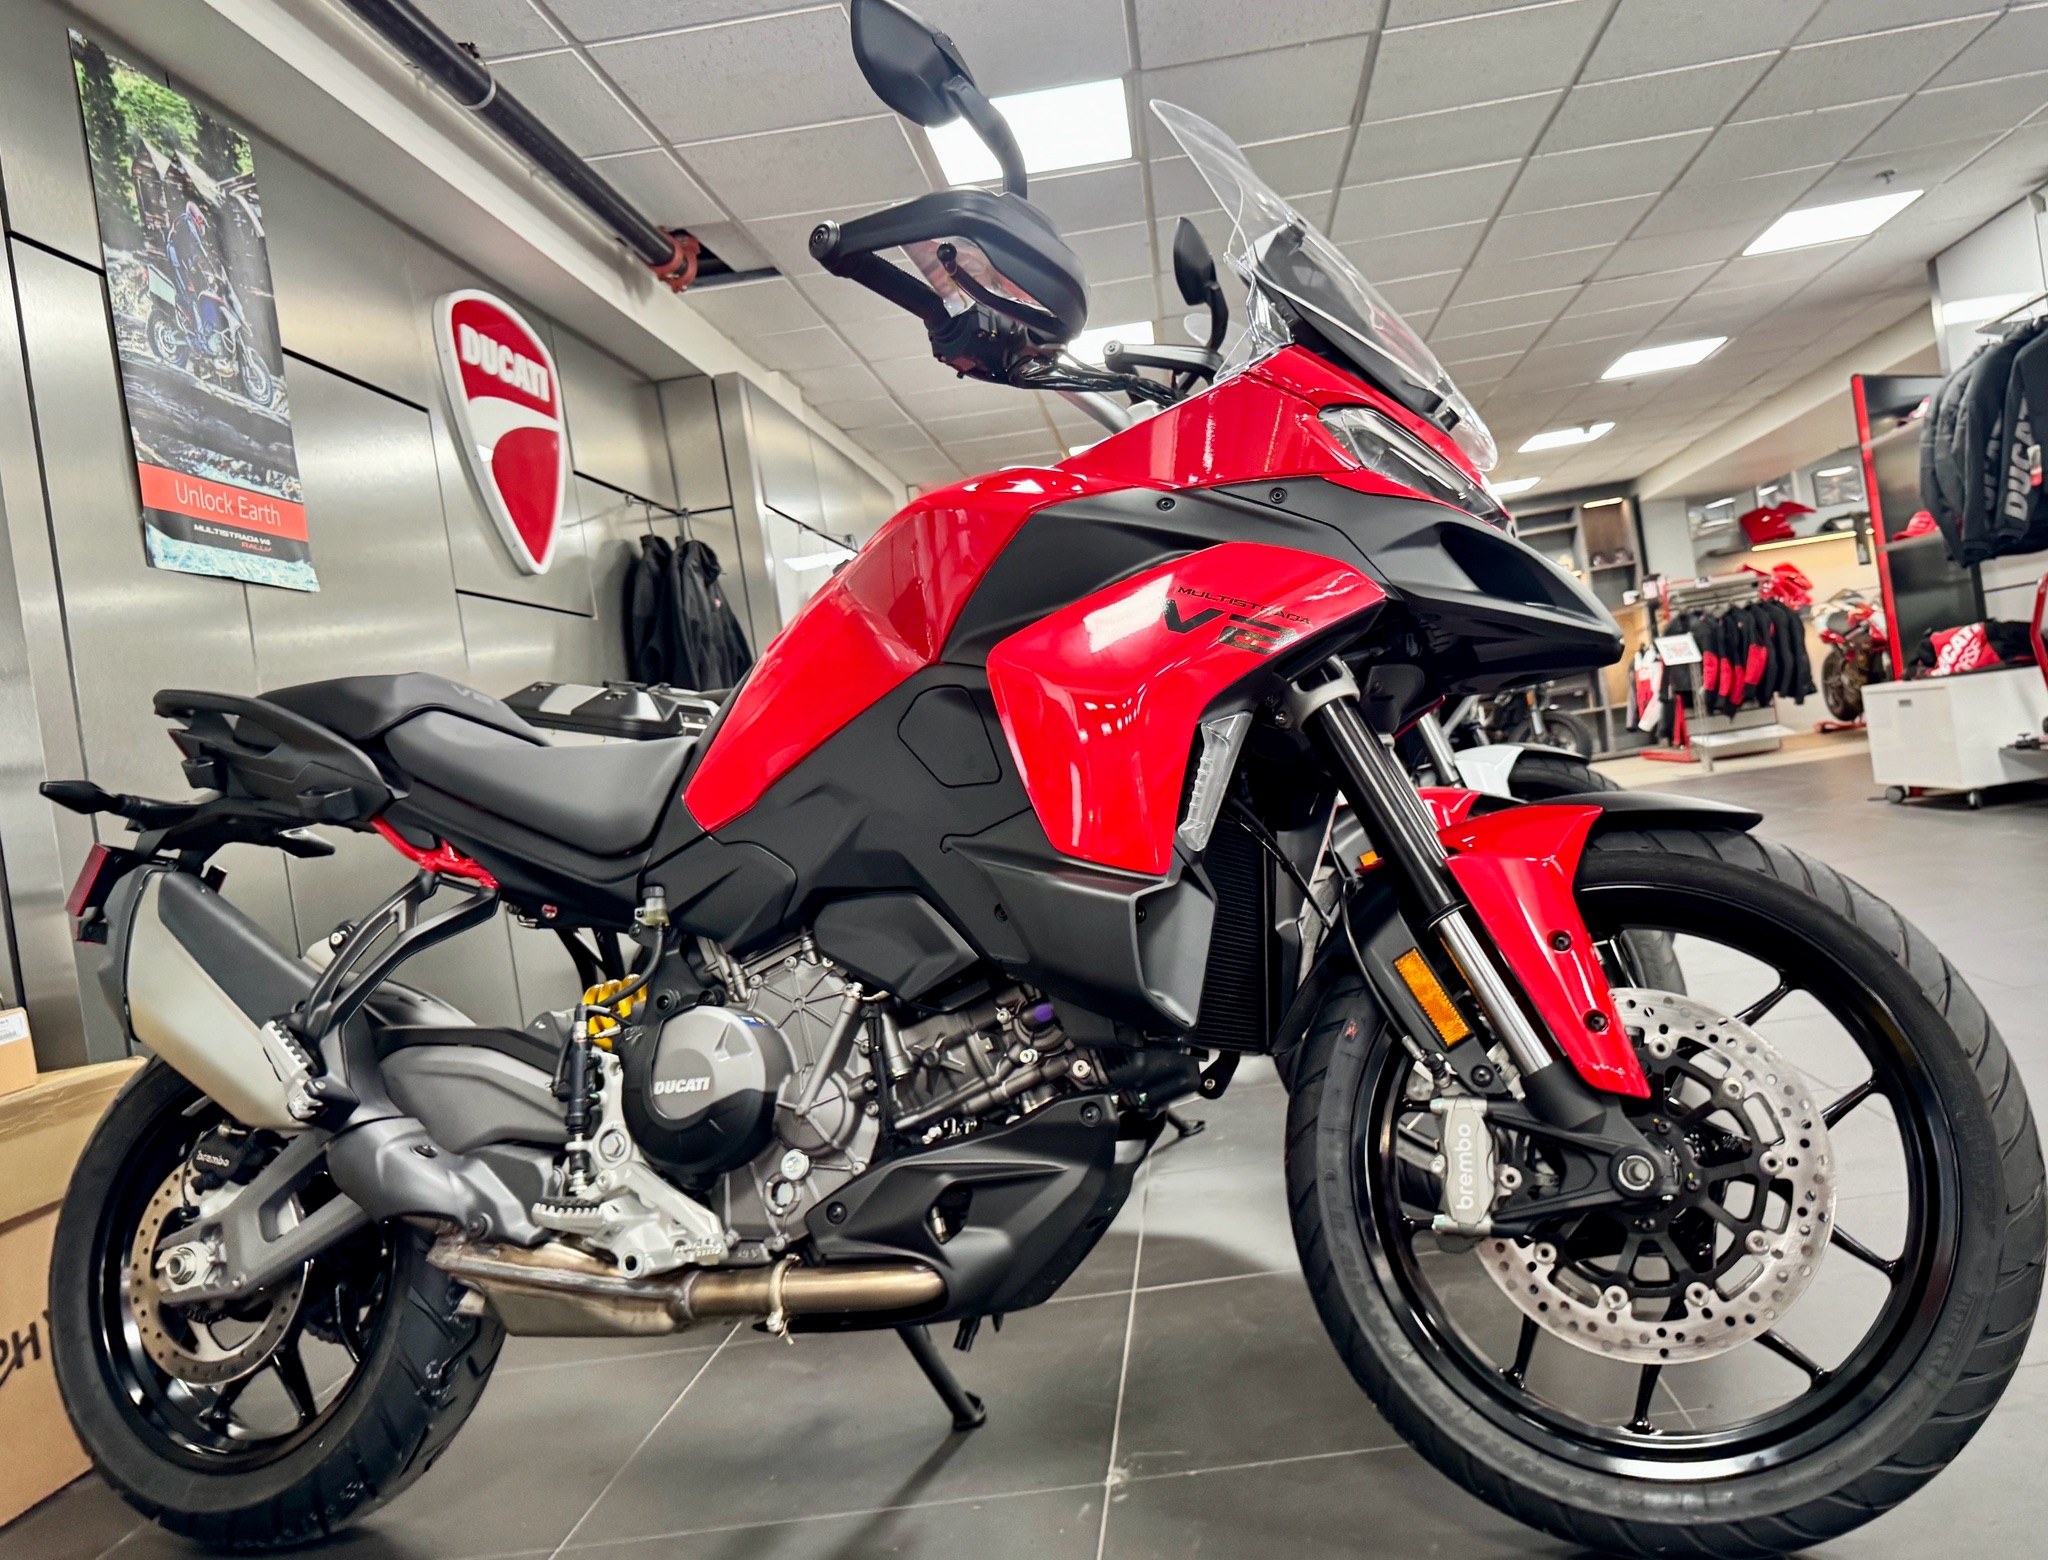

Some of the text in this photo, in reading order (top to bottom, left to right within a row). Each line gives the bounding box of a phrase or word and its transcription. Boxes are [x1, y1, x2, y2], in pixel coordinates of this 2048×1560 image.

[459, 324, 549, 402] DUCATI
[2004, 394, 2033, 520] DUCA
[175, 480, 281, 526] Unlock Earth
[194, 524, 272, 546] MULTISTRADA V4
[1163, 599, 1300, 656] V2
[654, 1076, 710, 1095] DUCATI
[196, 1150, 229, 1167] brembo
[1455, 1124, 1474, 1210] brembo
